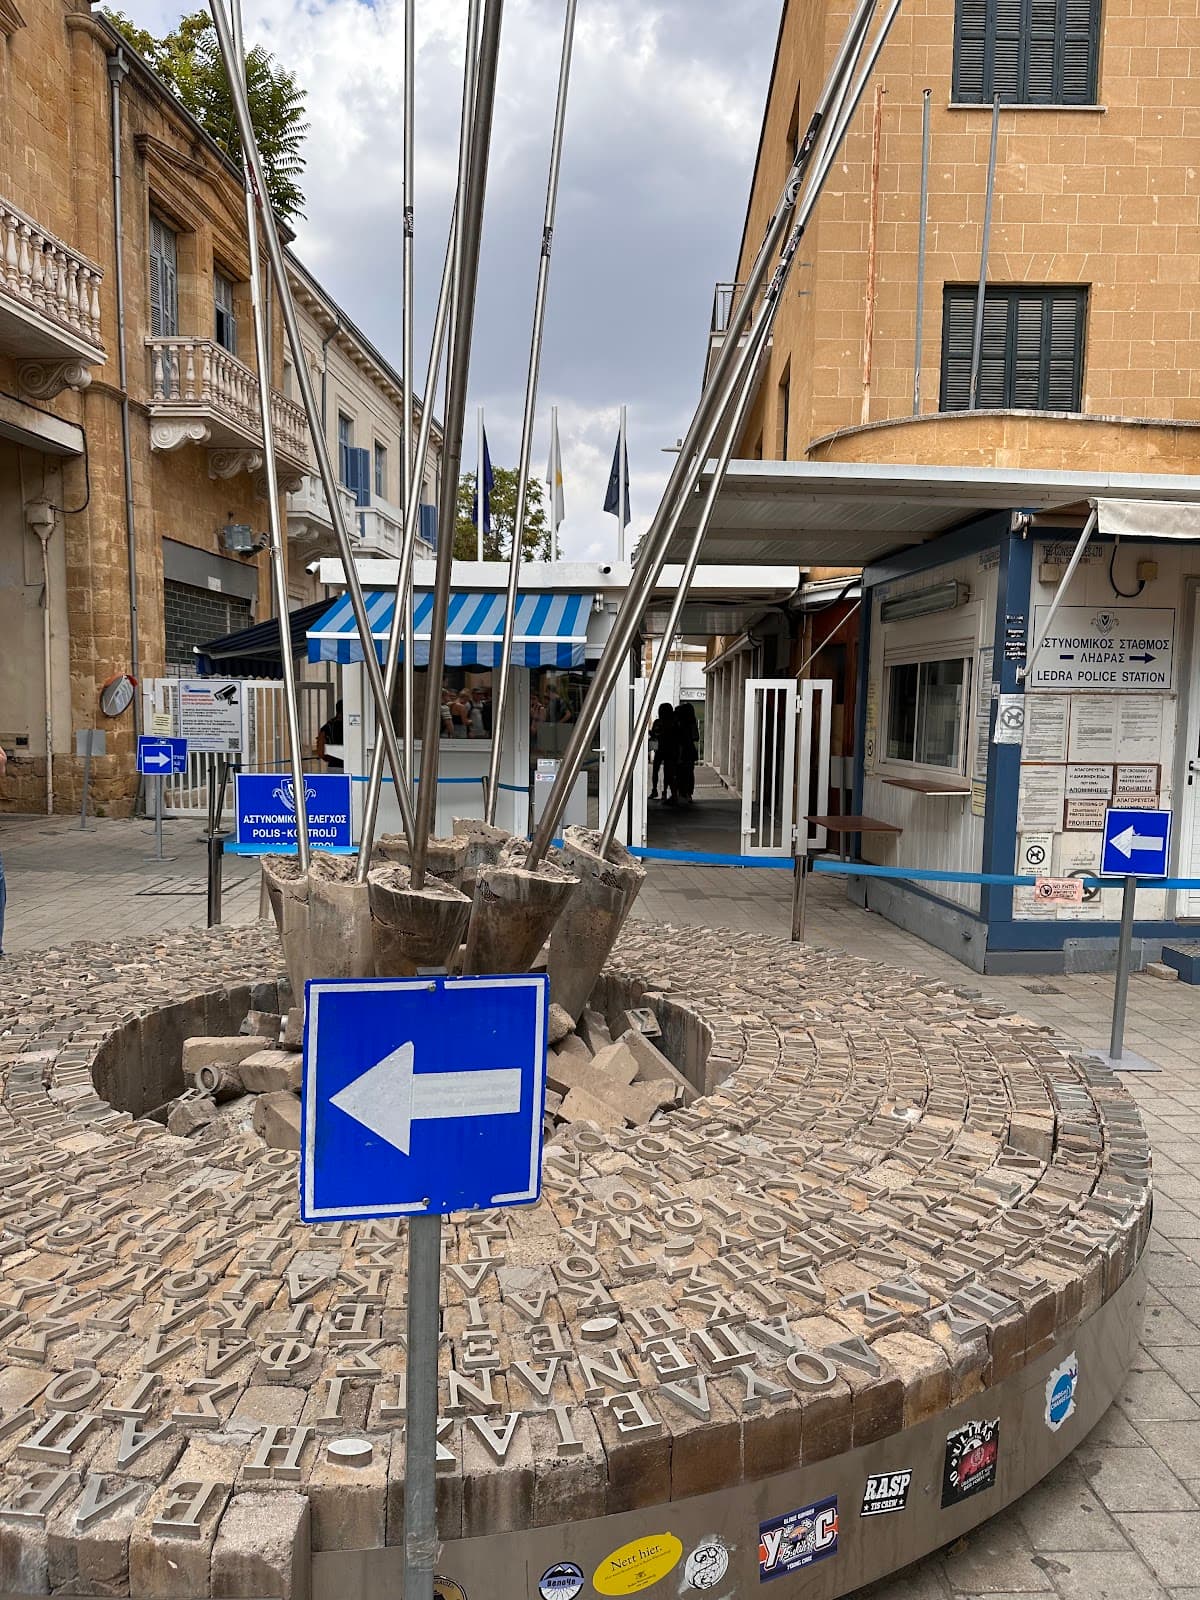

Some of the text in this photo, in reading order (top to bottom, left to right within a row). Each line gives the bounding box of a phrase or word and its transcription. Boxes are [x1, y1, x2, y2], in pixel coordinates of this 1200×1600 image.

[1041, 638, 1169, 650] ΣΤΥΝΟΜΙΚΟΣ ΣΤΑΘΜΟΣ
[1080, 653, 1125, 663] ΛΗΔΡΑΣ
[1037, 670, 1165, 683] LEDRA POLICE STATION
[243, 814, 347, 824] ΑΣΤΥΝΟΜΙΚ ΕΛΕΓΧΟΣ
[458, 1276, 622, 1328] ΚΑΙ
[618, 1263, 850, 1340] ΔΙΚΗ
[864, 1473, 911, 1501] RASP
[881, 1499, 898, 1509] CREW
[610, 1555, 637, 1571] Nett
[638, 1544, 662, 1560] hier.
